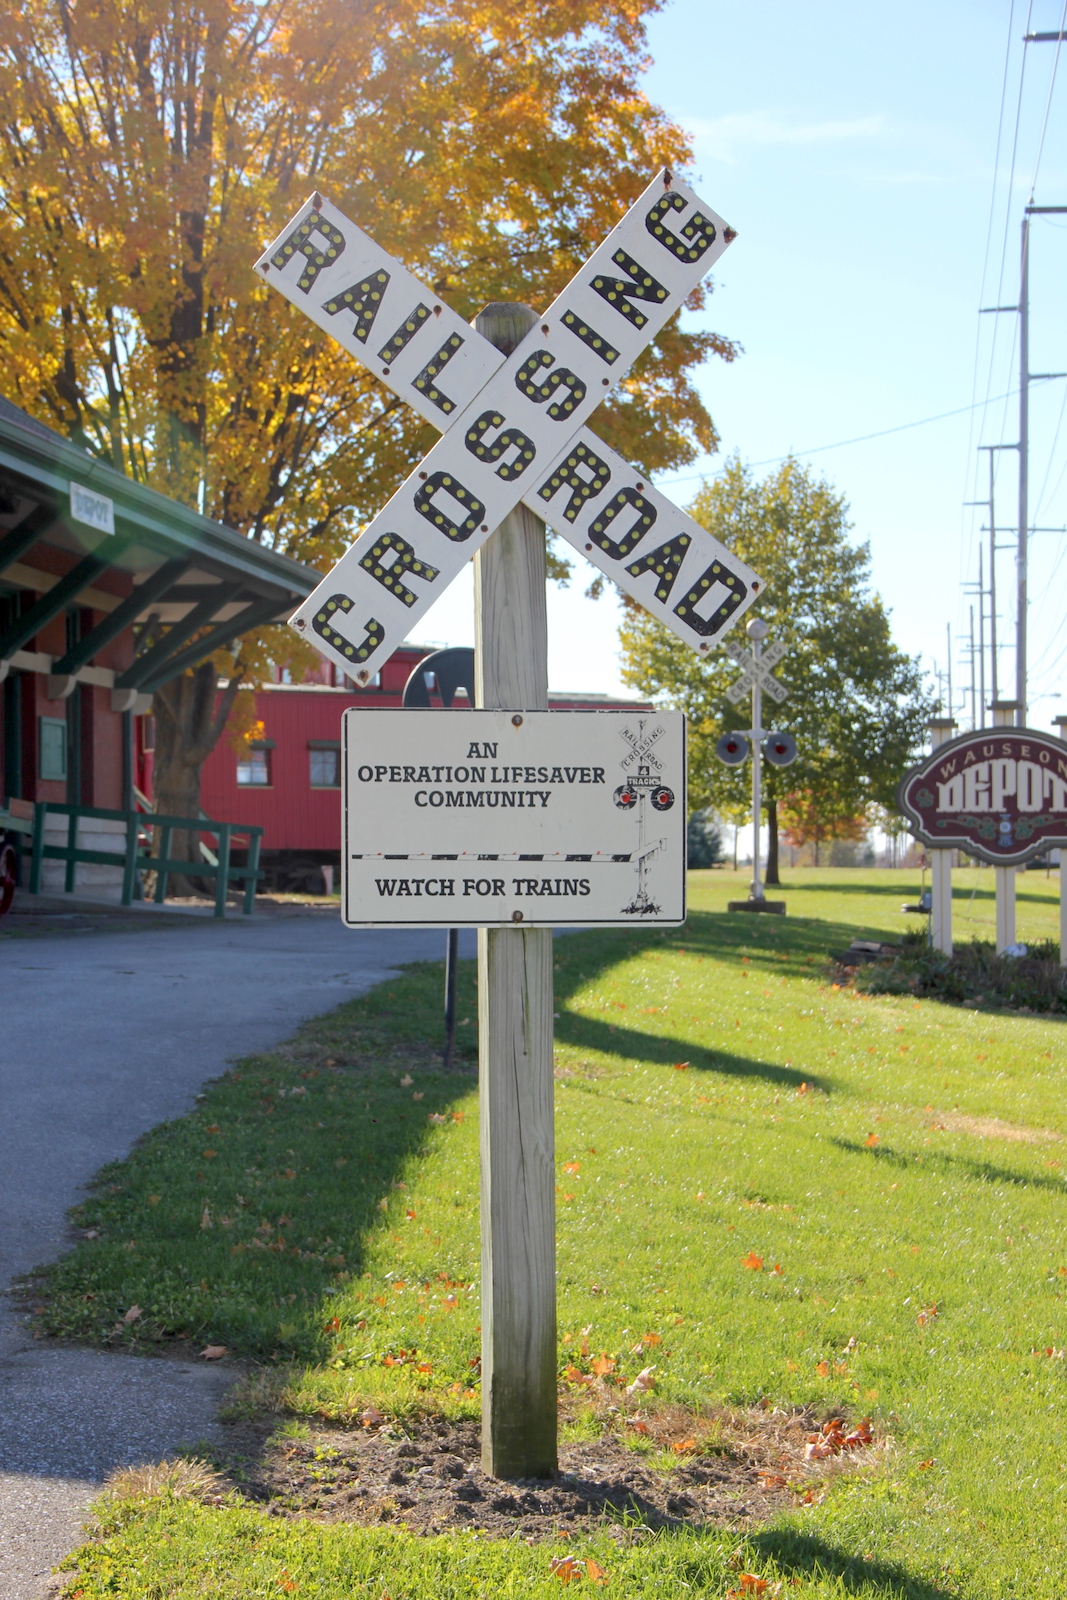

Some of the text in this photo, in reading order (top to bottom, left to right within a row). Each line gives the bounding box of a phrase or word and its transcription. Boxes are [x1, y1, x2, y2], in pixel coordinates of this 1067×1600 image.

[270, 208, 466, 416] RAIL
[311, 191, 717, 664] CROSSING
[536, 441, 748, 637] ROAD
[729, 644, 749, 667] RAIL
[731, 645, 782, 698] CROSSING
[761, 676, 785, 699] ROAD
[622, 729, 639, 747] RAIL
[623, 727, 663, 767] CROSSING
[466, 742, 498, 759] AN
[645, 752, 663, 770] ROAD
[357, 765, 606, 784] OPERATION LIFESAVER
[639, 766, 649, 775] 4
[628, 778, 661, 786] TRACKS
[935, 757, 1067, 813] DEPOT
[414, 790, 552, 808] COMMUNITY
[375, 878, 591, 897] WATCH FOR TRAINS
